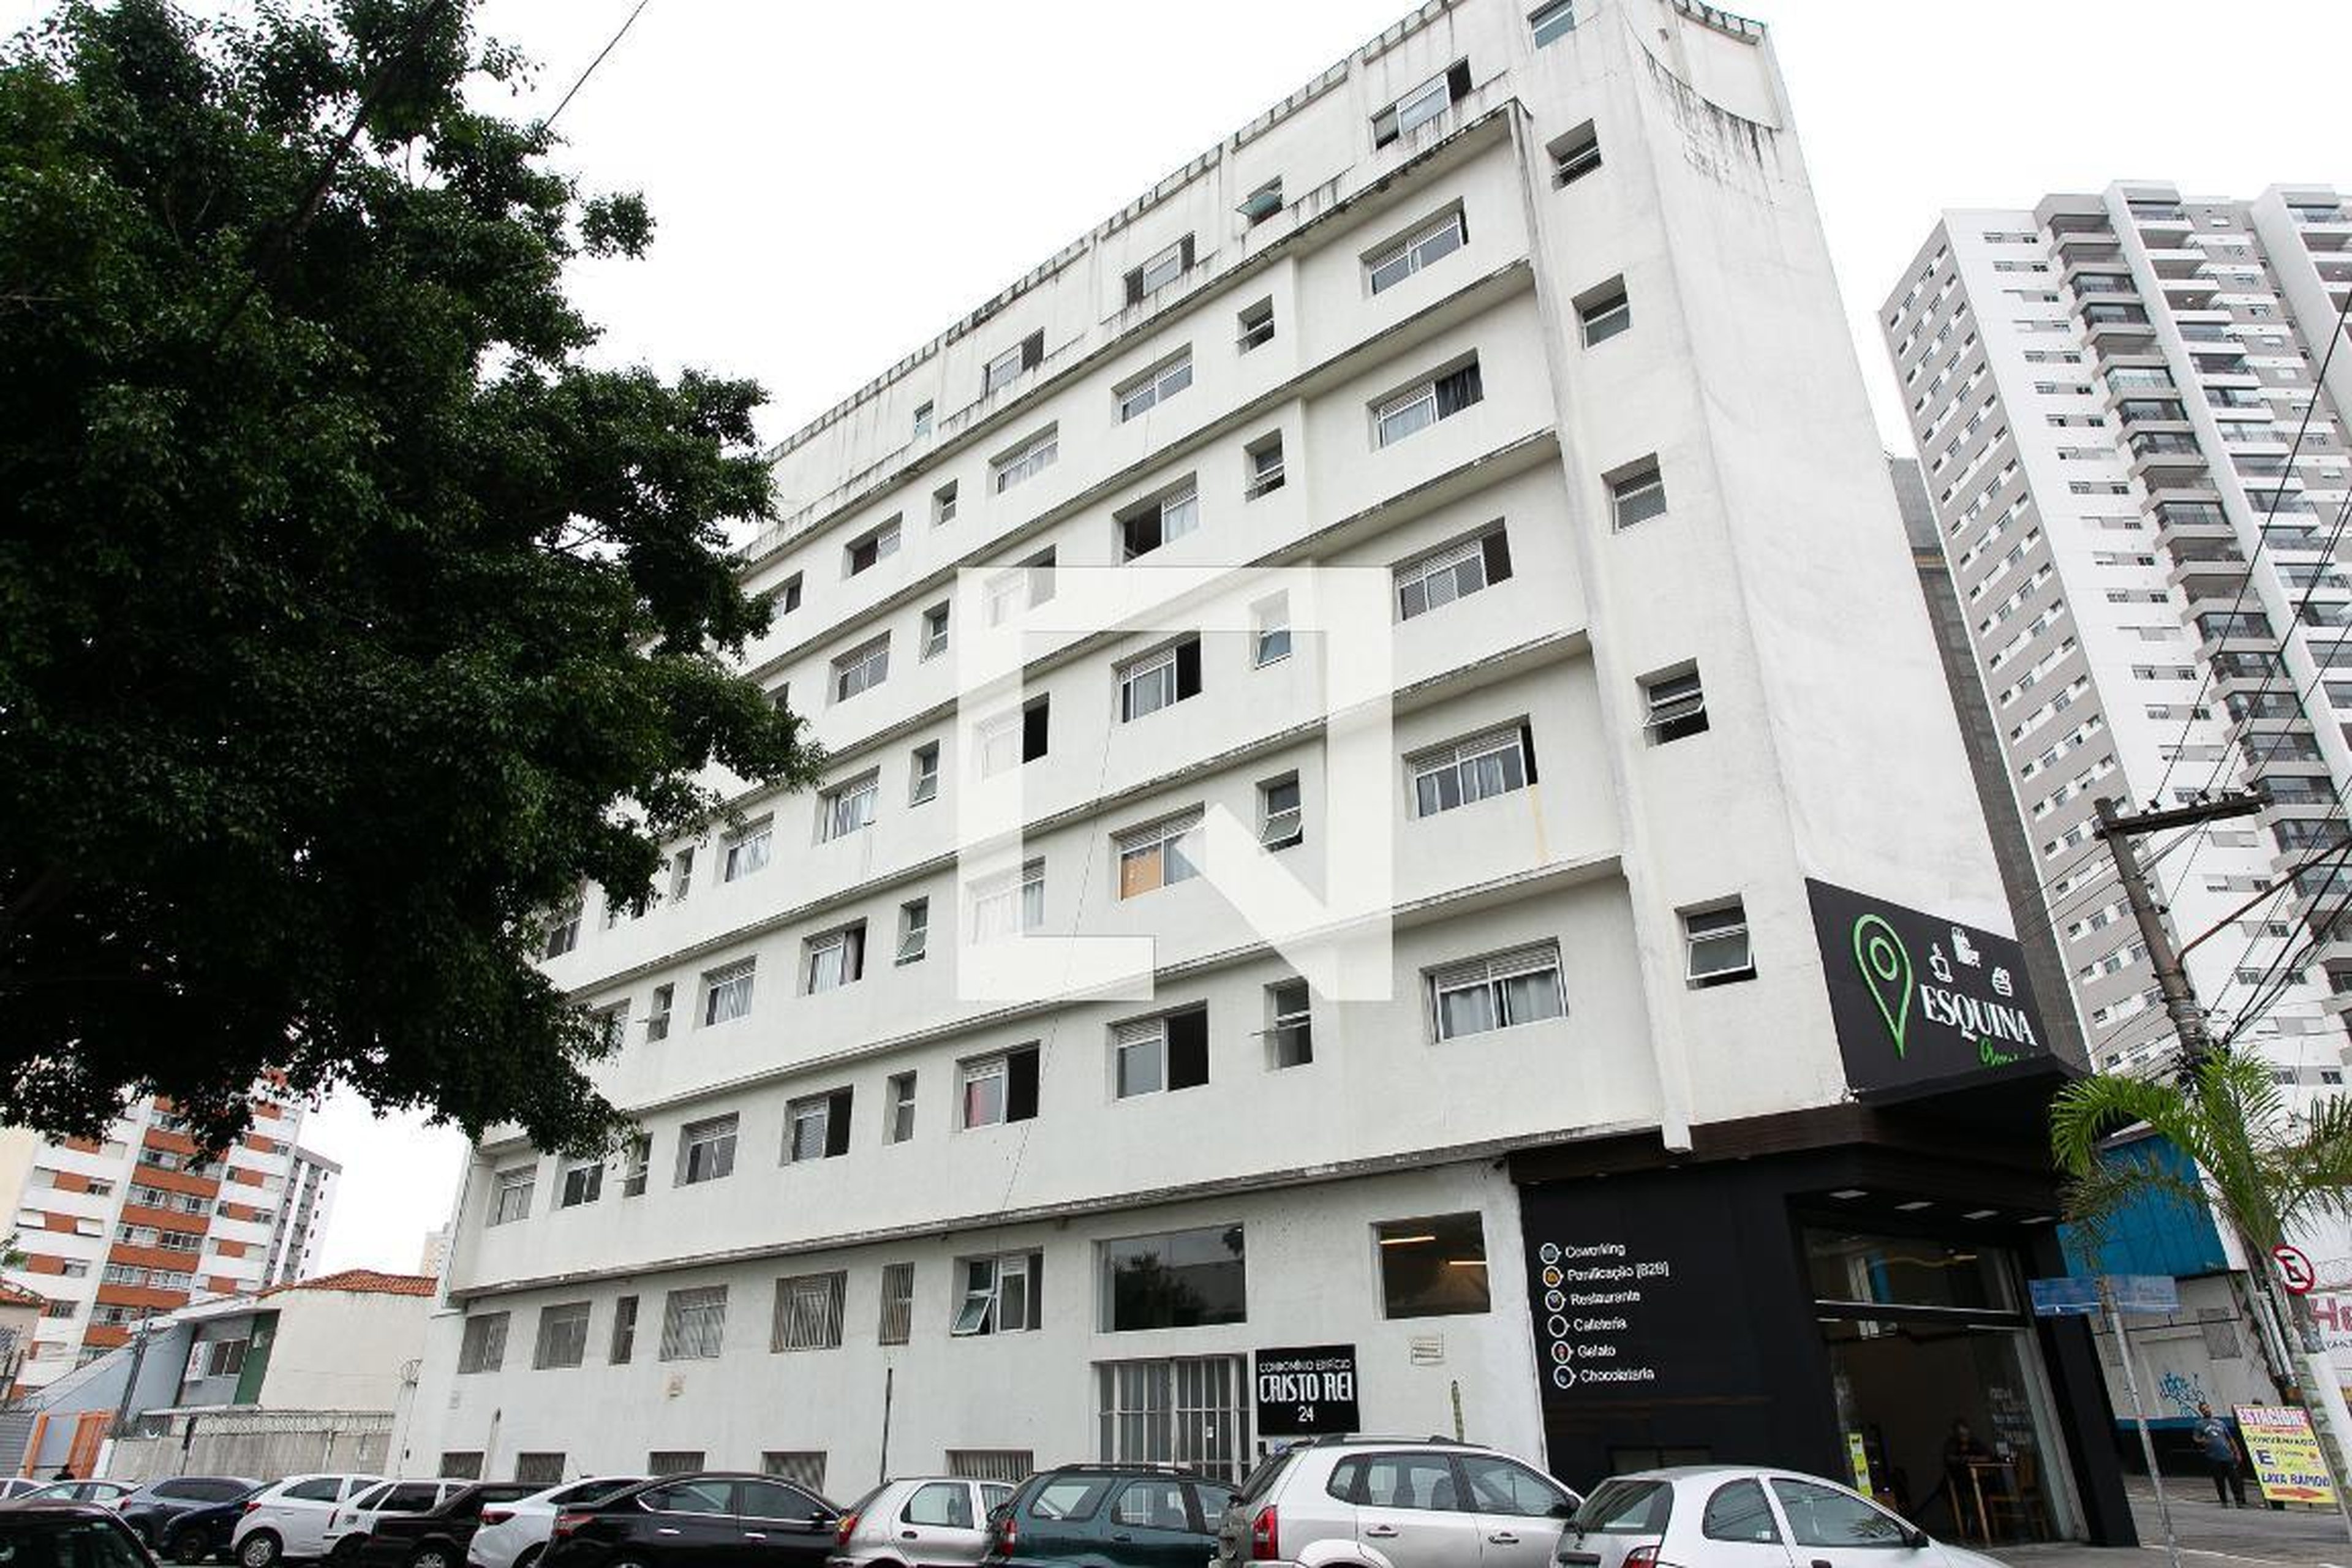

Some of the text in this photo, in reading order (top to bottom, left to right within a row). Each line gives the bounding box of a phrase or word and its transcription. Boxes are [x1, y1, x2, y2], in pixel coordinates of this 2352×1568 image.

[1920, 984, 2038, 1047] ESQUINA
[1565, 1243, 1626, 1258] Coworking
[1570, 1290, 1640, 1305] Restaurante
[1573, 1317, 1627, 1332] Cafeteria
[1577, 1344, 1616, 1358] Gelato
[1259, 1371, 1353, 1403] CRISTO REI
[1297, 1405, 1314, 1422] 24
